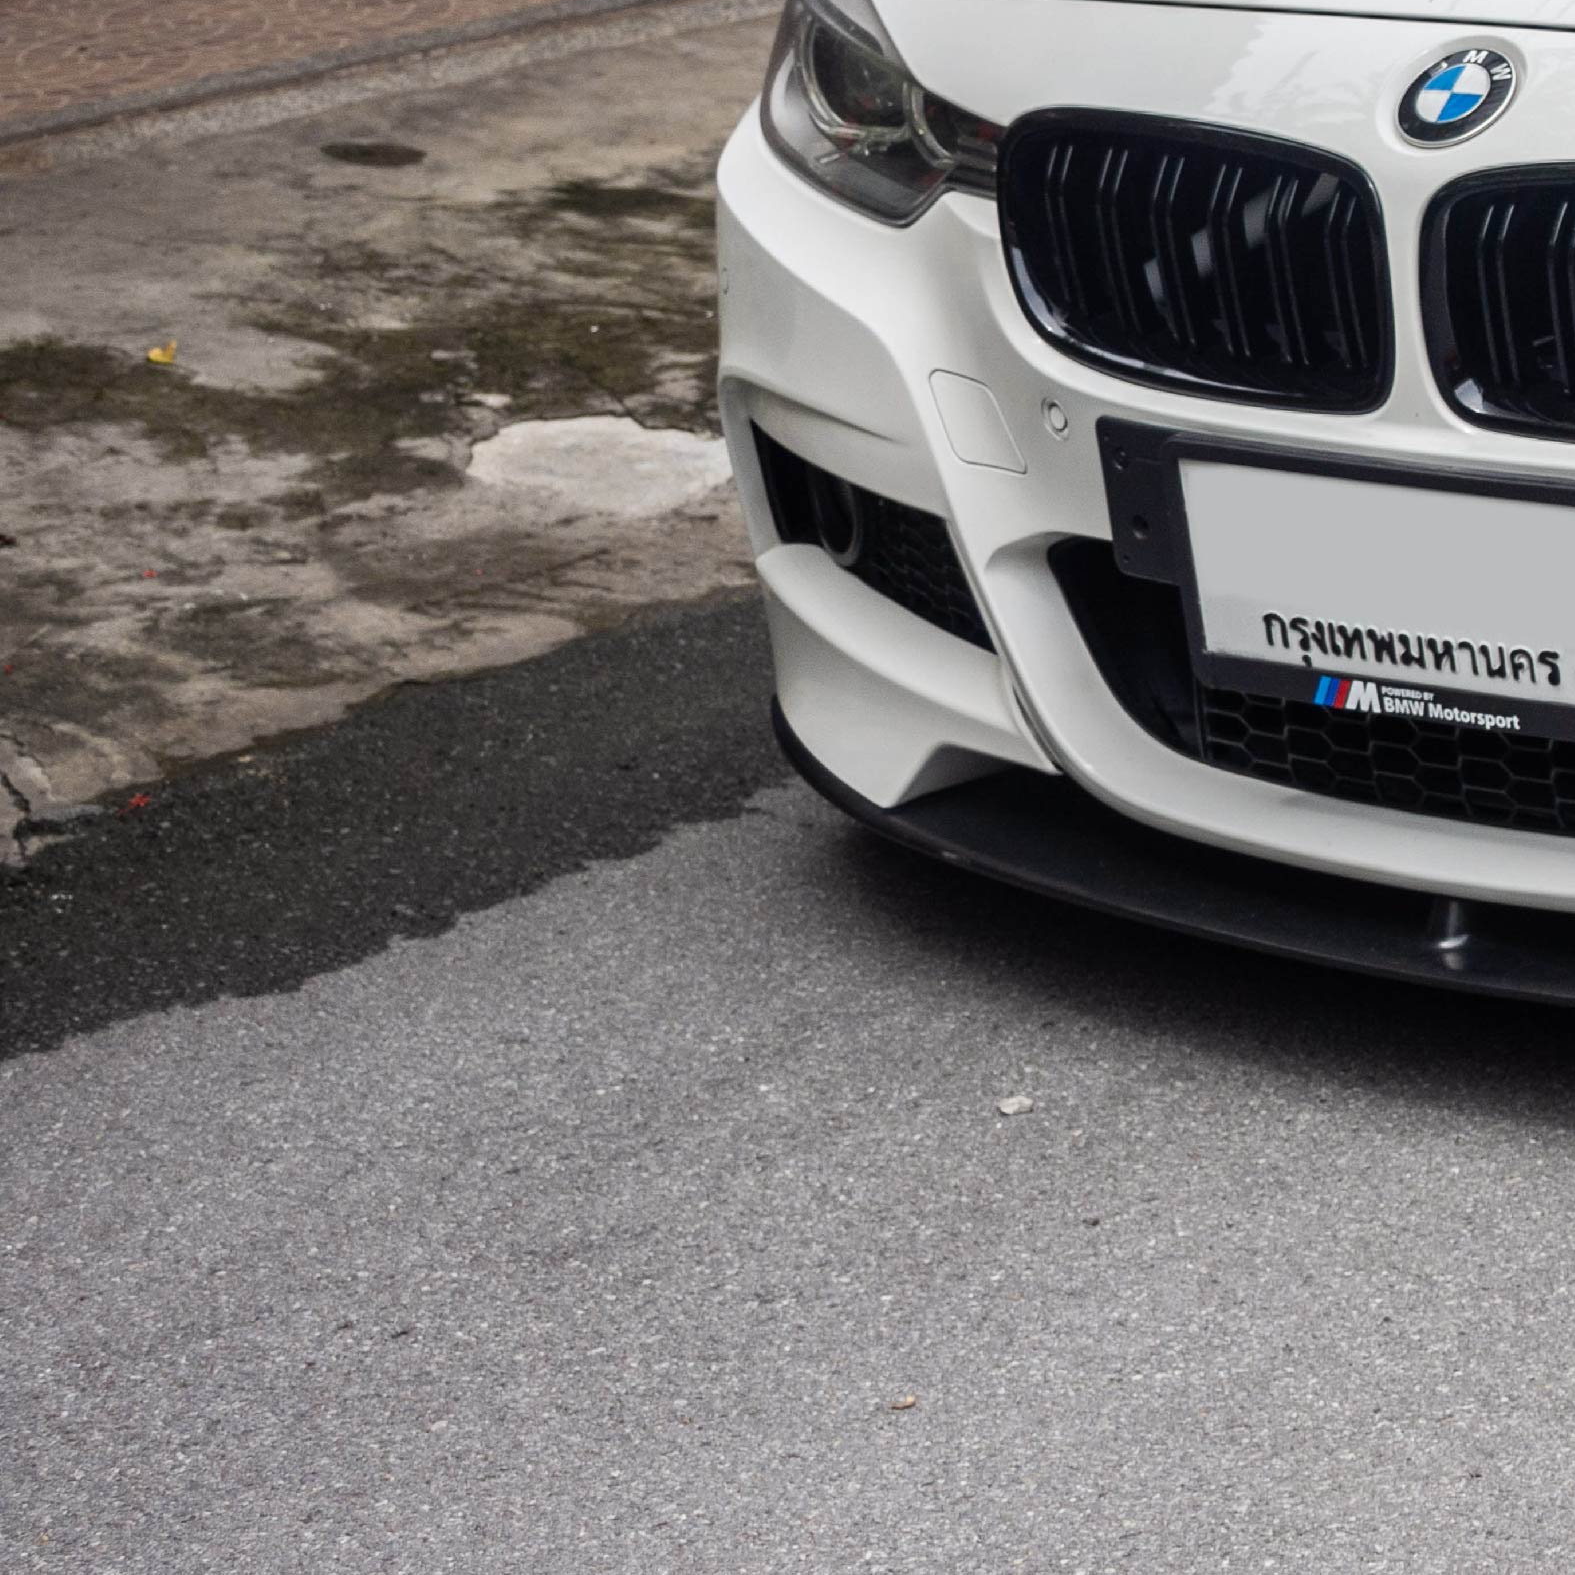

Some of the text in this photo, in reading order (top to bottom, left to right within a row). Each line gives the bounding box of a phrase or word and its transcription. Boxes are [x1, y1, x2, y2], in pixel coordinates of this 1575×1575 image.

[1262, 611, 1562, 686] กรุงเทพมหานคร
[1381, 685, 1435, 702] POWERED BY
[1383, 696, 1520, 730] BMW Motorsport
